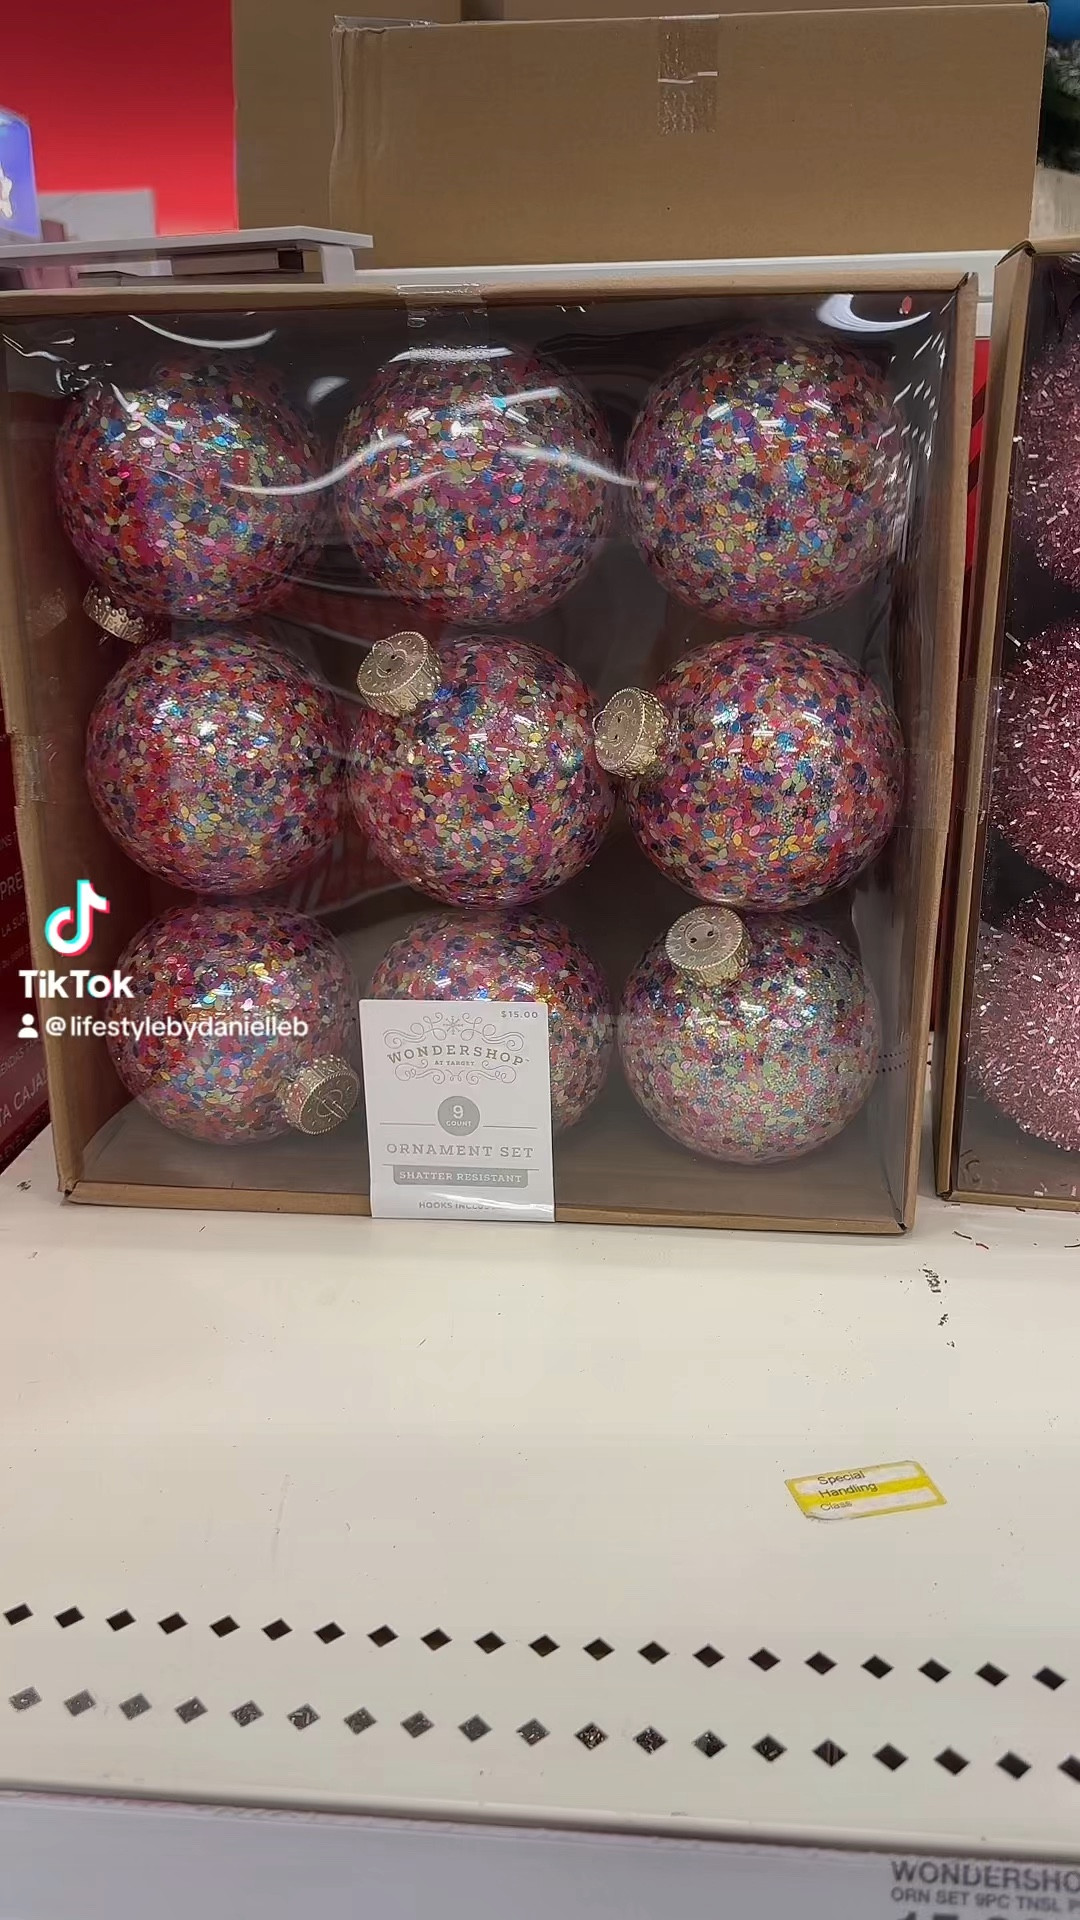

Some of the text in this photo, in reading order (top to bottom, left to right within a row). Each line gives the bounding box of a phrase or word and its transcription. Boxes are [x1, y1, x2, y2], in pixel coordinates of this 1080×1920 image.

[501, 1010, 539, 1019] $15.00
[387, 1045, 524, 1067] WONDERSHOP
[452, 1105, 464, 1119] 9
[386, 1143, 534, 1158] ORNAMENT SET
[399, 1171, 522, 1184] SHATTER RESISTANT
[418, 1201, 453, 1209] HOOKS
[817, 1470, 866, 1486] Special
[818, 1483, 878, 1498] Handling
[891, 1860, 1080, 1893] WONDERSHO
[891, 1886, 931, 1903] ORN
[936, 1890, 970, 1906] SET
[975, 1893, 1010, 1910] 9PC
[1015, 1895, 1062, 1912] TNSL
